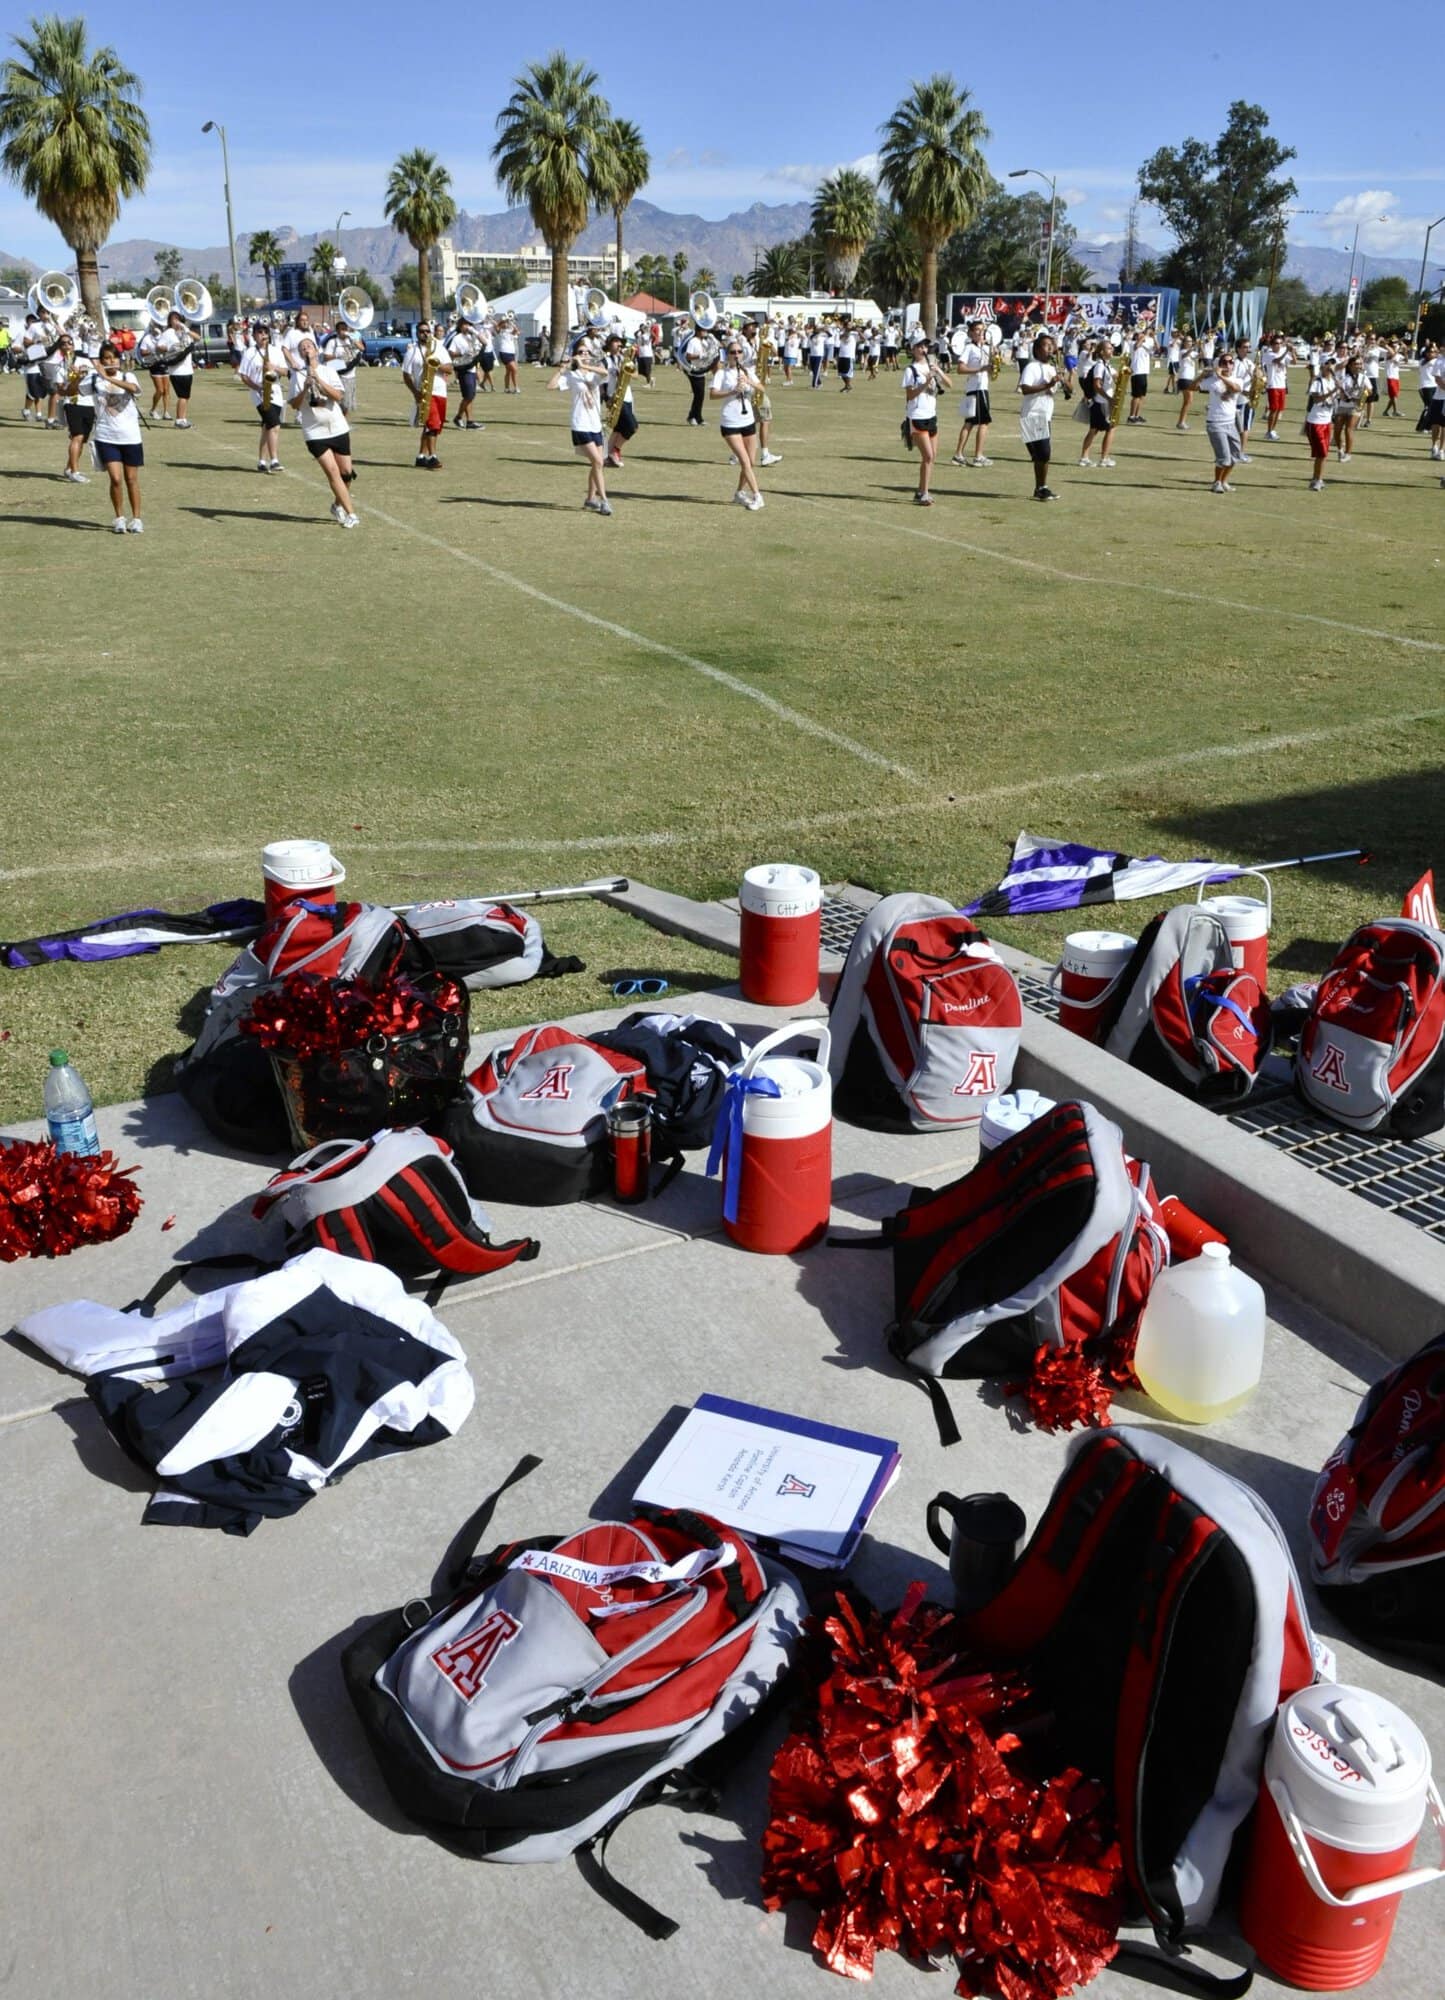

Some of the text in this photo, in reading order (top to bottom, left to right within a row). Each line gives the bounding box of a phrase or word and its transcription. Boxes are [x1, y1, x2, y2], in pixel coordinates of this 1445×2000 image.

[975, 297, 997, 324] A
[519, 1064, 576, 1100] A
[953, 1051, 998, 1096] A
[1311, 1042, 1351, 1094] A
[737, 1486, 757, 1511] Arizona
[776, 1473, 816, 1498] A
[427, 1609, 523, 1706] A
[1293, 1722, 1361, 1781] Jessie
